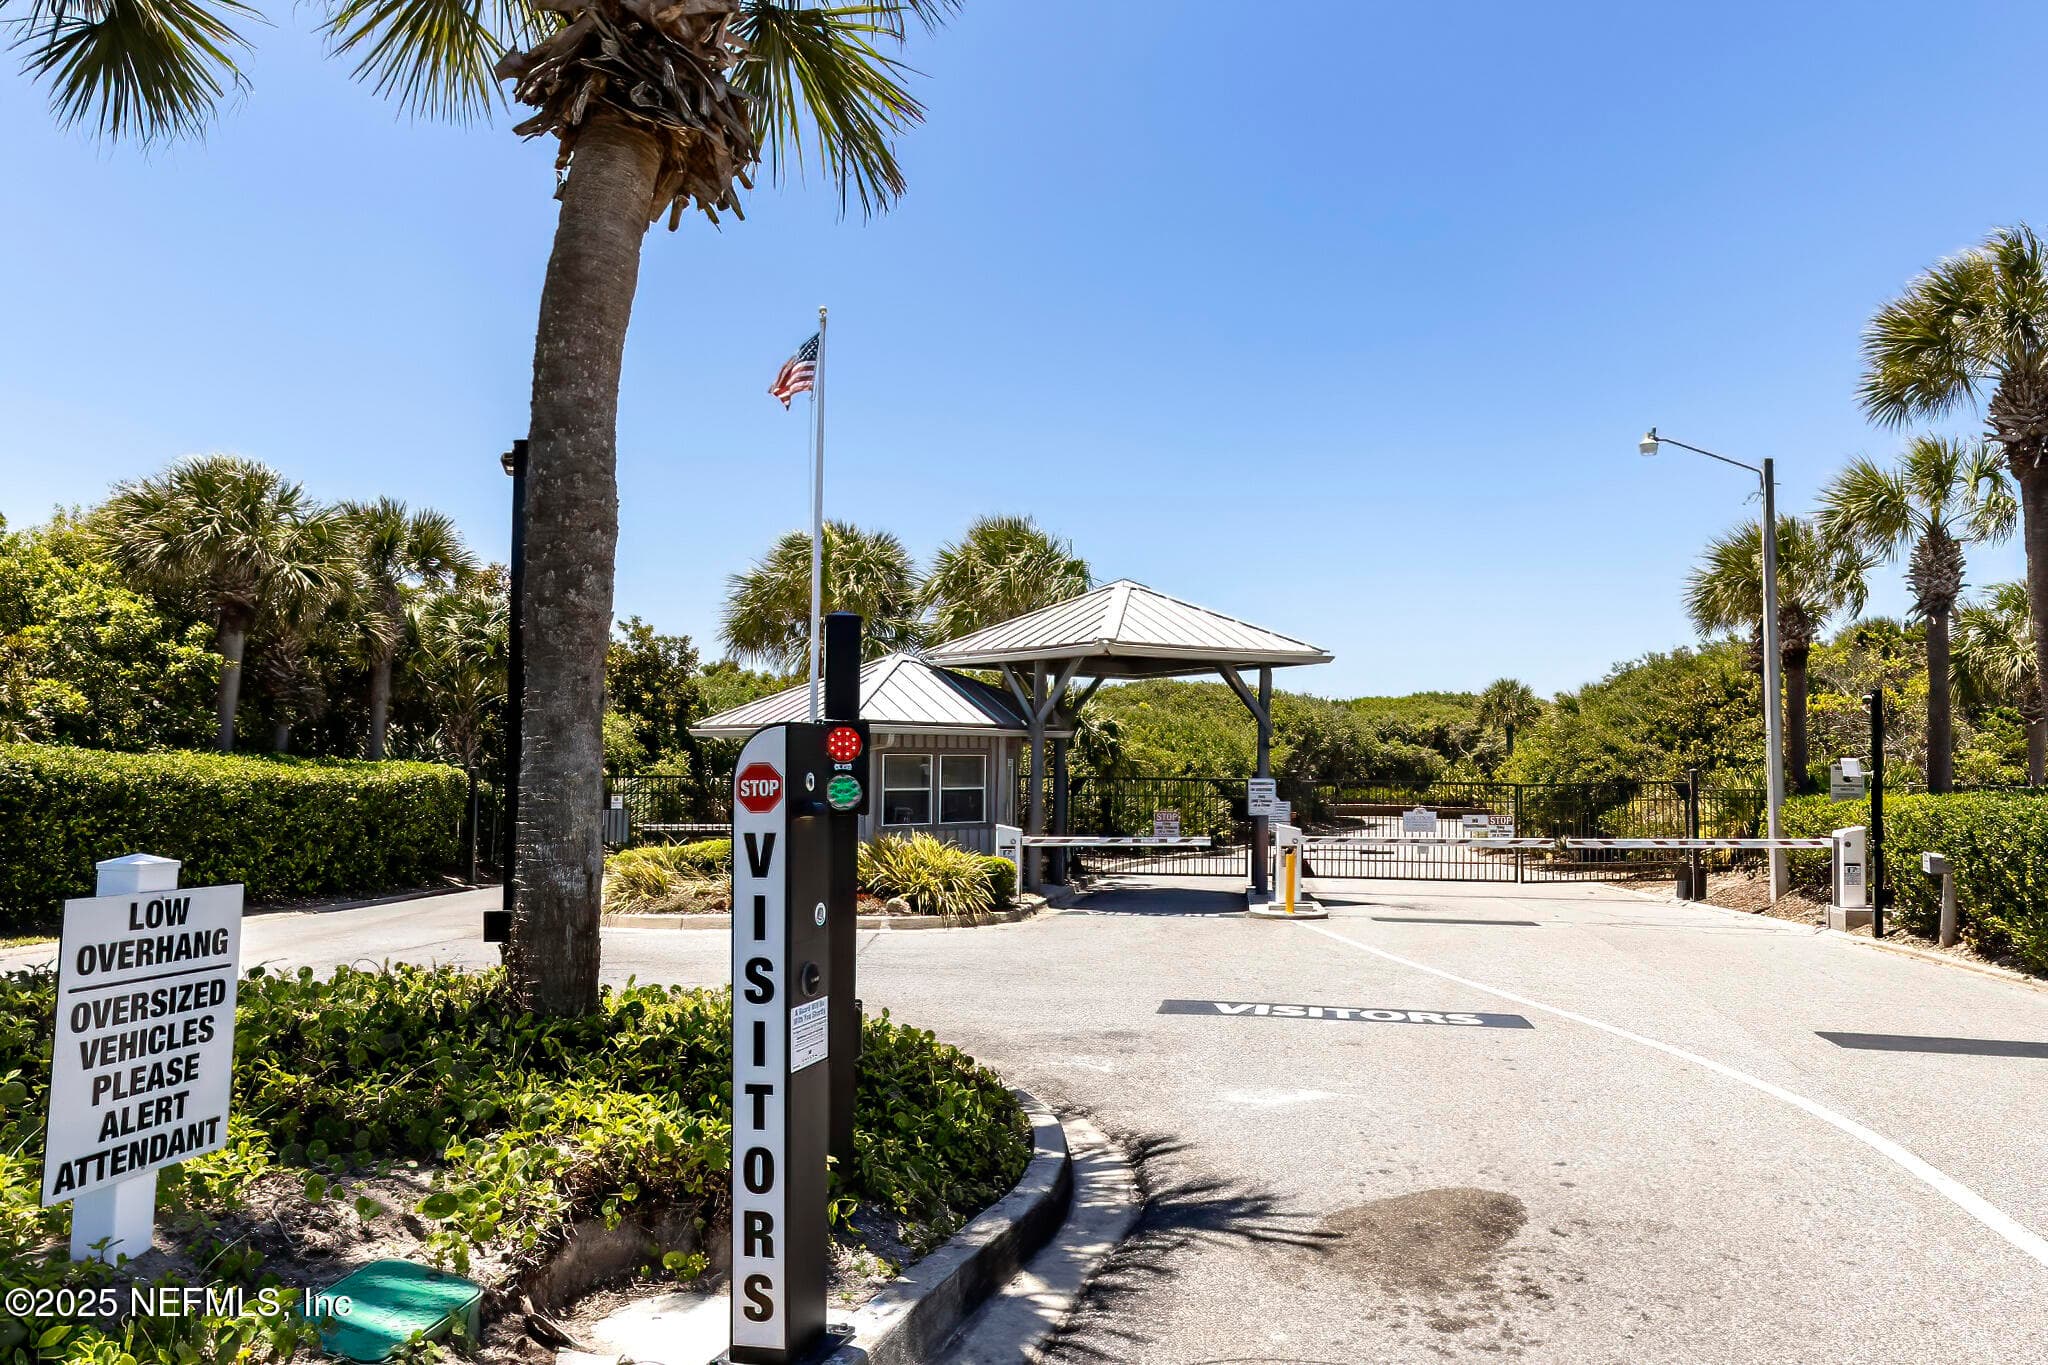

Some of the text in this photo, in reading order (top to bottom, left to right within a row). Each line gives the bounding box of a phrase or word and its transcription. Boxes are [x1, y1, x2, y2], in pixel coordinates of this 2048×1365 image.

[740, 779, 779, 797] STOP
[1156, 812, 1178, 821] STOP
[1490, 816, 1512, 825] STOP
[128, 897, 191, 931] LOW
[76, 928, 229, 976] OVERHANG
[71, 979, 226, 1034] OVERSIZED
[1213, 1002, 1485, 1025] VISITORS
[79, 1015, 215, 1070] VEHICLES
[92, 1053, 200, 1107] PLEASE
[743, 832, 777, 1323] VISITORS
[98, 1092, 190, 1144] ALERT
[52, 1116, 222, 1197] ATTENDANT
